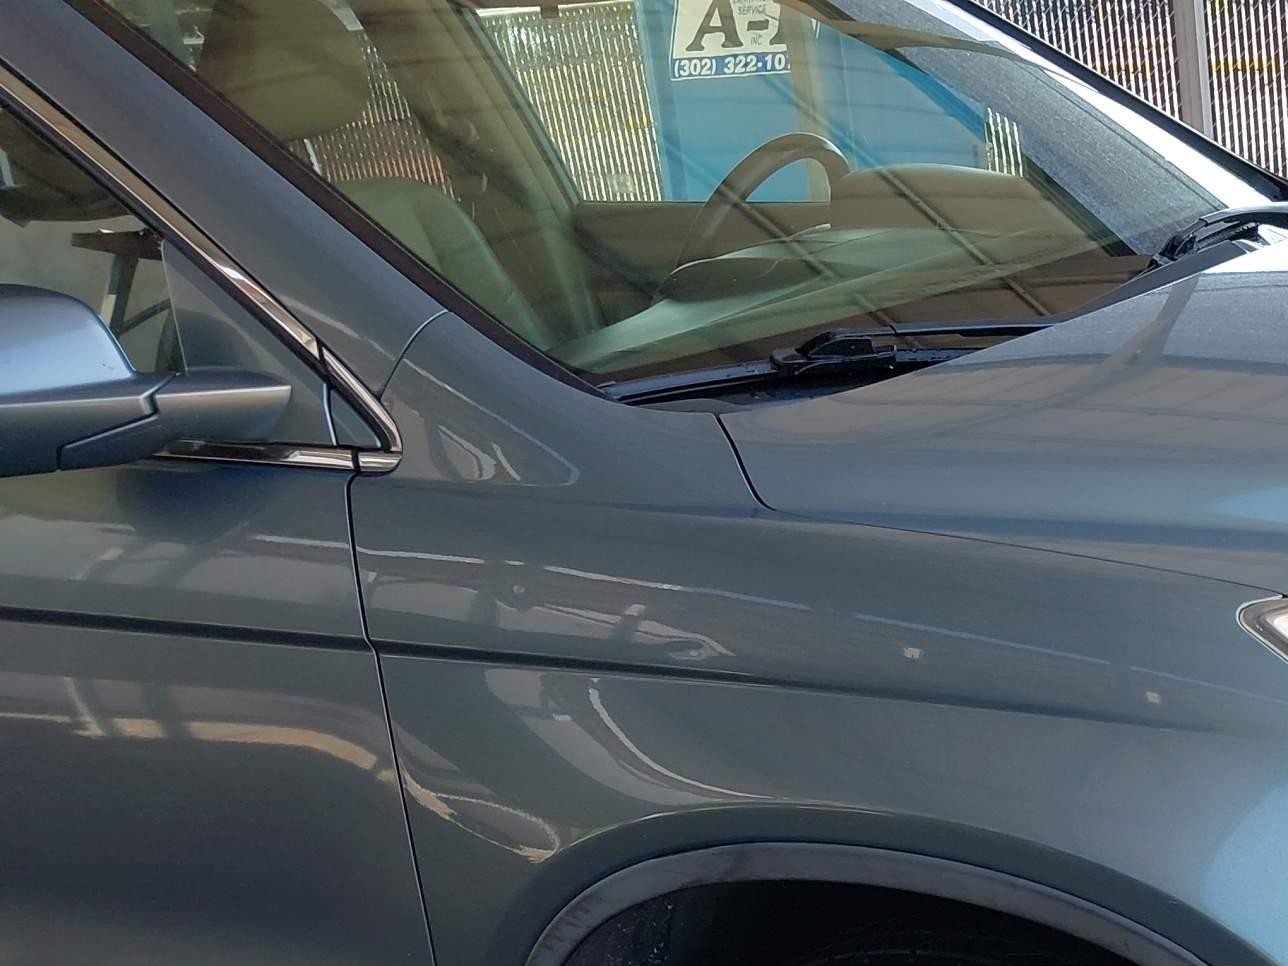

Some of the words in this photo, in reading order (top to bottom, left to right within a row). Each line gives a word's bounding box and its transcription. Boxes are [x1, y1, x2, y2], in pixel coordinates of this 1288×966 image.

[737, 4, 768, 16] SERVICE
[674, 58, 716, 78] (302)
[723, 53, 791, 74] 322-10
